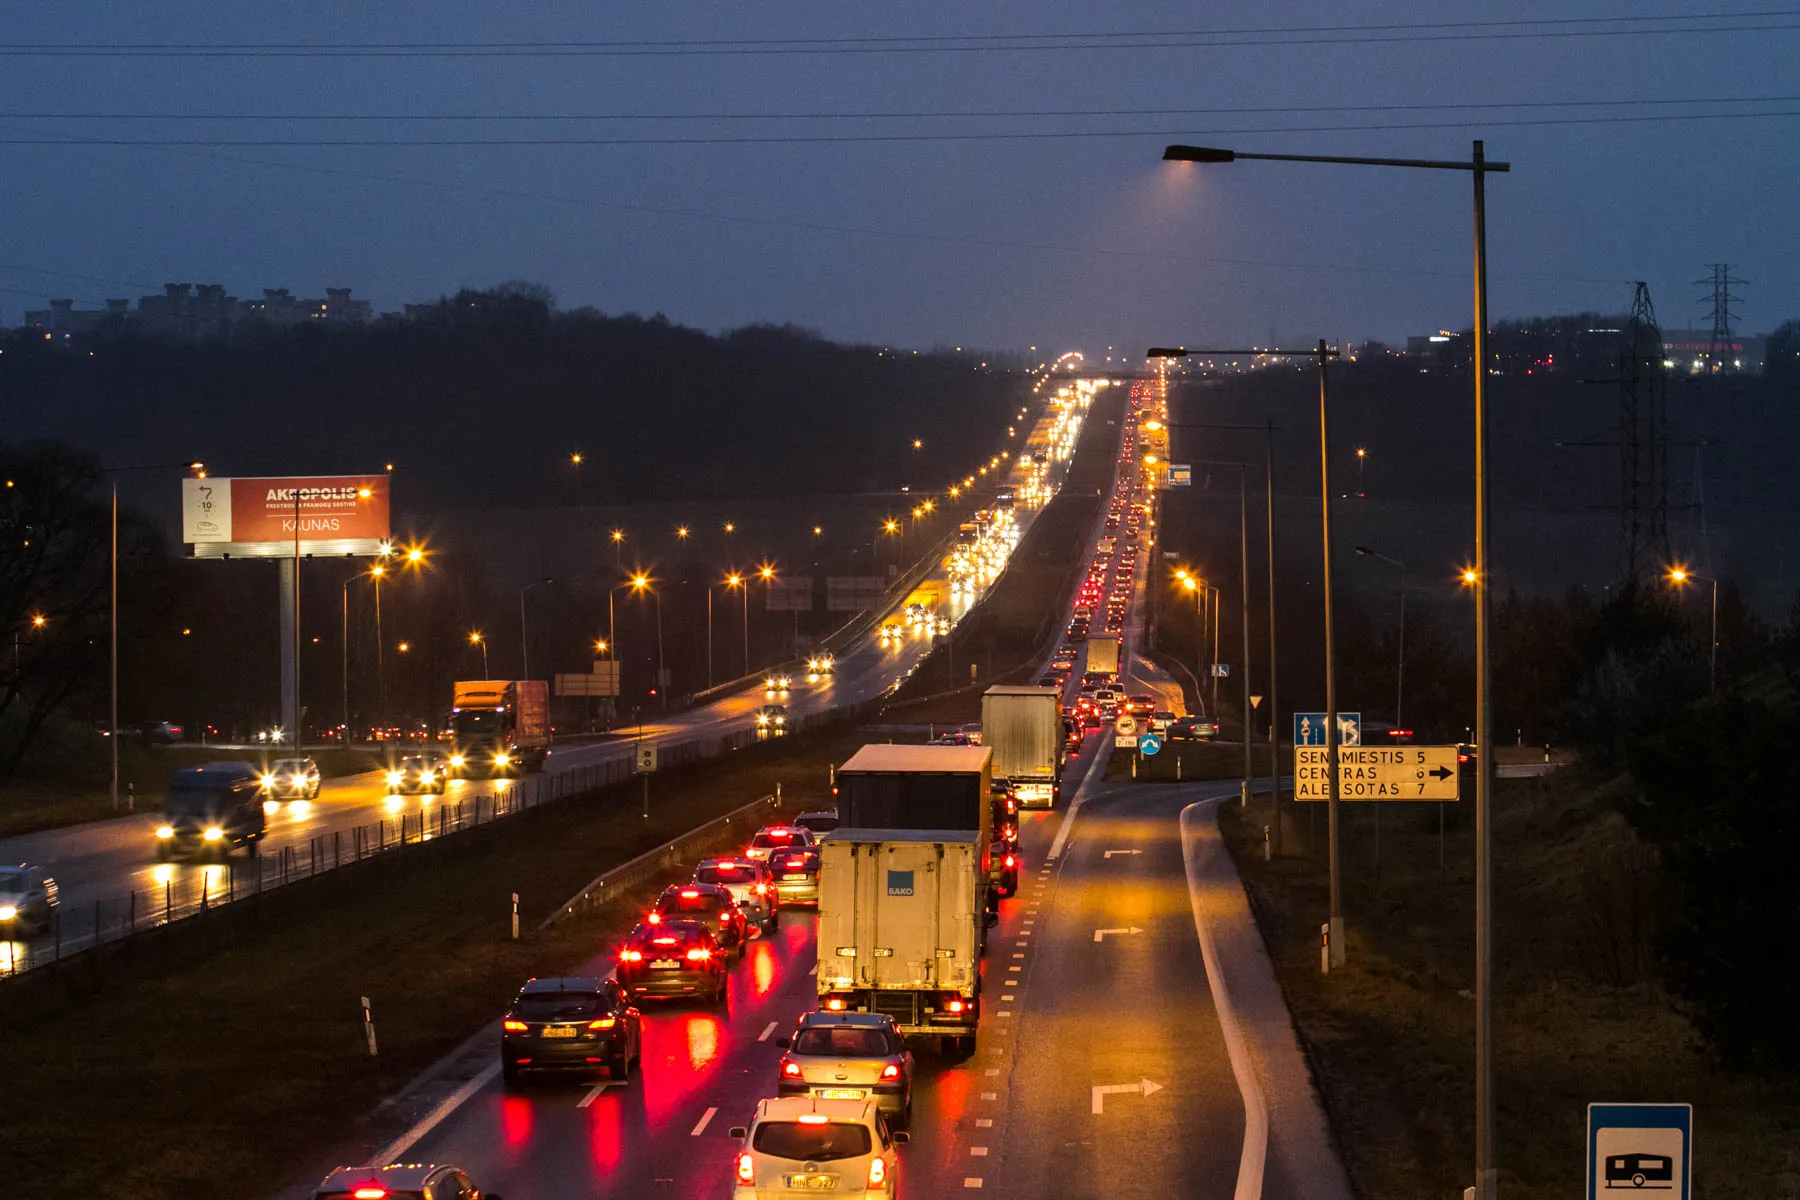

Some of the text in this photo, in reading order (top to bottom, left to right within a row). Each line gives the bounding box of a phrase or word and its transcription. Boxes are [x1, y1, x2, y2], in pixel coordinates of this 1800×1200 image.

[266, 487, 356, 500] AKROPOLIS
[202, 501, 212, 509] 10
[282, 519, 340, 531] KAUNAS
[1299, 751, 1425, 764] SENMIESTIS 5
[1299, 767, 1424, 779] CENRAS 6
[1300, 783, 1425, 795] ALESOTAS 7
[888, 887, 913, 895] BAKO
